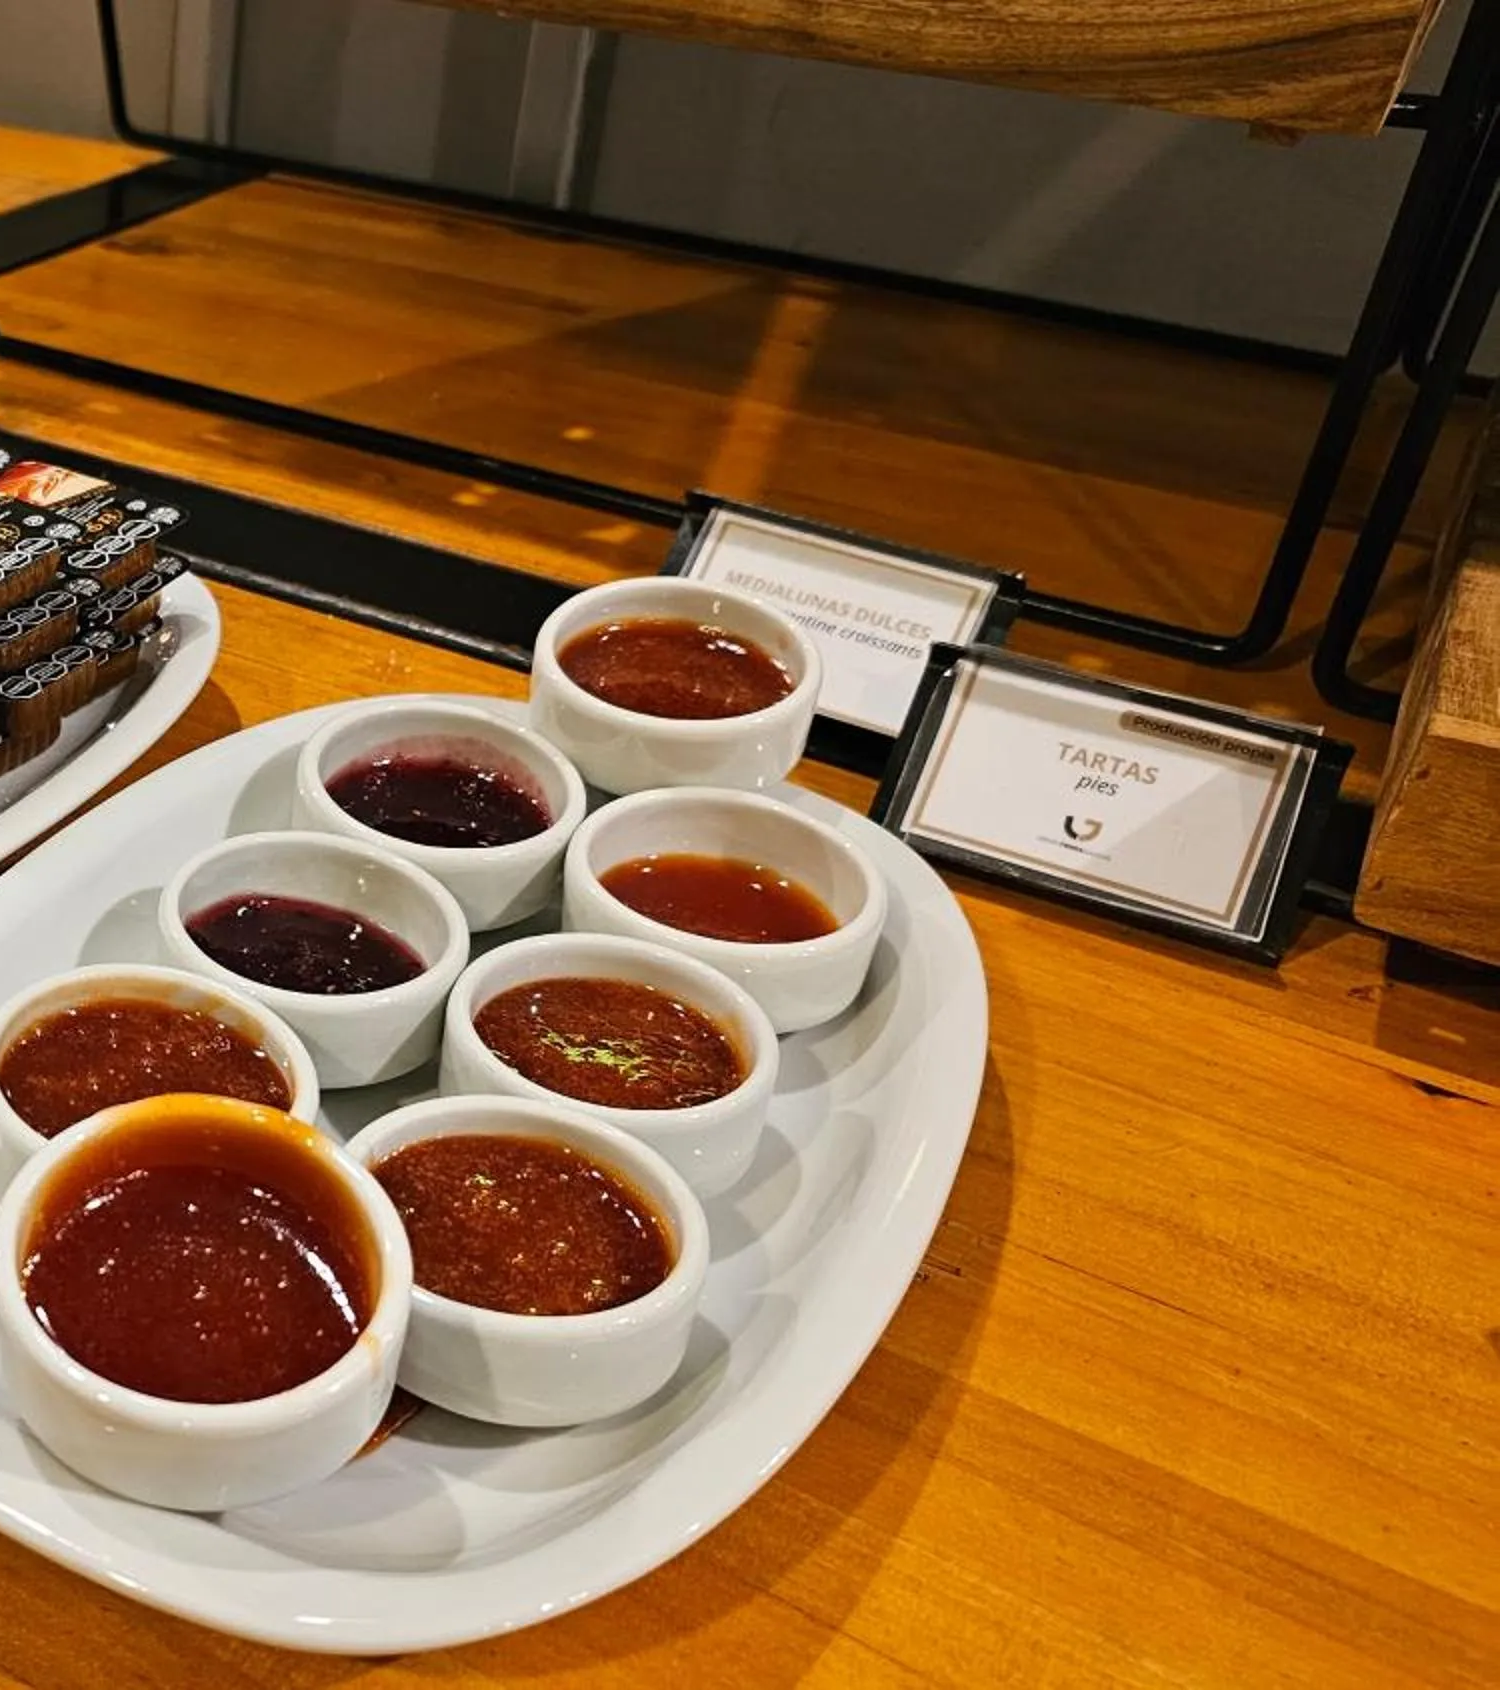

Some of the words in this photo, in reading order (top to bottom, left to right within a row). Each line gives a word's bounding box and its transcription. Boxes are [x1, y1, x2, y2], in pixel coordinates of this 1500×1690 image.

[724, 569, 849, 618] MEDIALUNAS
[854, 606, 934, 641] DULCES
[839, 627, 924, 659] croissants
[1058, 741, 1160, 785] TARTAS
[1224, 741, 1275, 762] propia
[1075, 773, 1120, 797] pies
